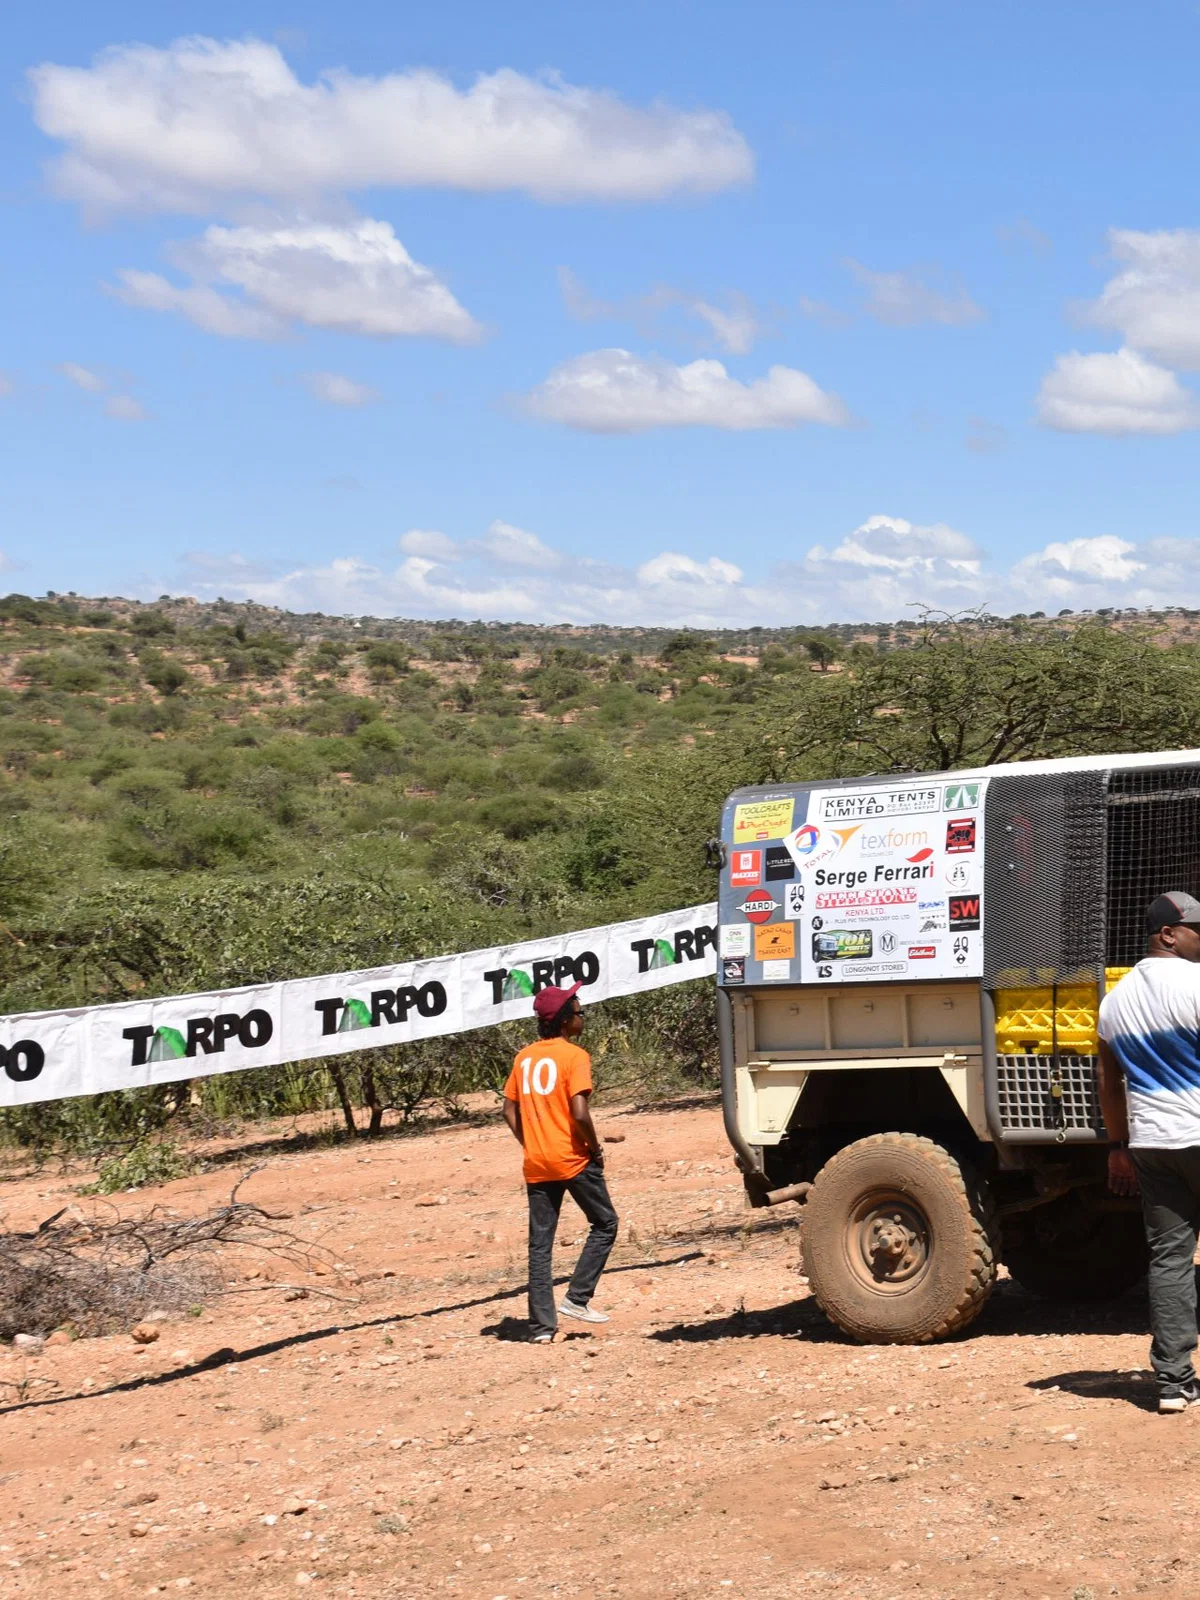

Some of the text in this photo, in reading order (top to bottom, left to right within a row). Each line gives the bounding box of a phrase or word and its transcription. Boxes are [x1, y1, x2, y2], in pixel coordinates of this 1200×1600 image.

[826, 791, 936, 808] KENYA TENTS
[740, 803, 791, 815] TOOLCRAFTS
[825, 805, 884, 818] LIMITED
[860, 828, 928, 850] texform
[803, 849, 833, 870] TOTAL
[815, 861, 934, 888] Serge Ferrari
[790, 885, 805, 897] 40
[815, 887, 917, 909] STEELSTONE
[744, 902, 773, 911] HARDI
[845, 909, 869, 917] KENYA
[950, 899, 979, 919] SW
[953, 936, 968, 948] 40
[845, 964, 904, 973] LONGONOT STORES
[315, 981, 447, 1035] TARPO
[123, 1009, 273, 1066] TARPO
[520, 1057, 557, 1096] 10
